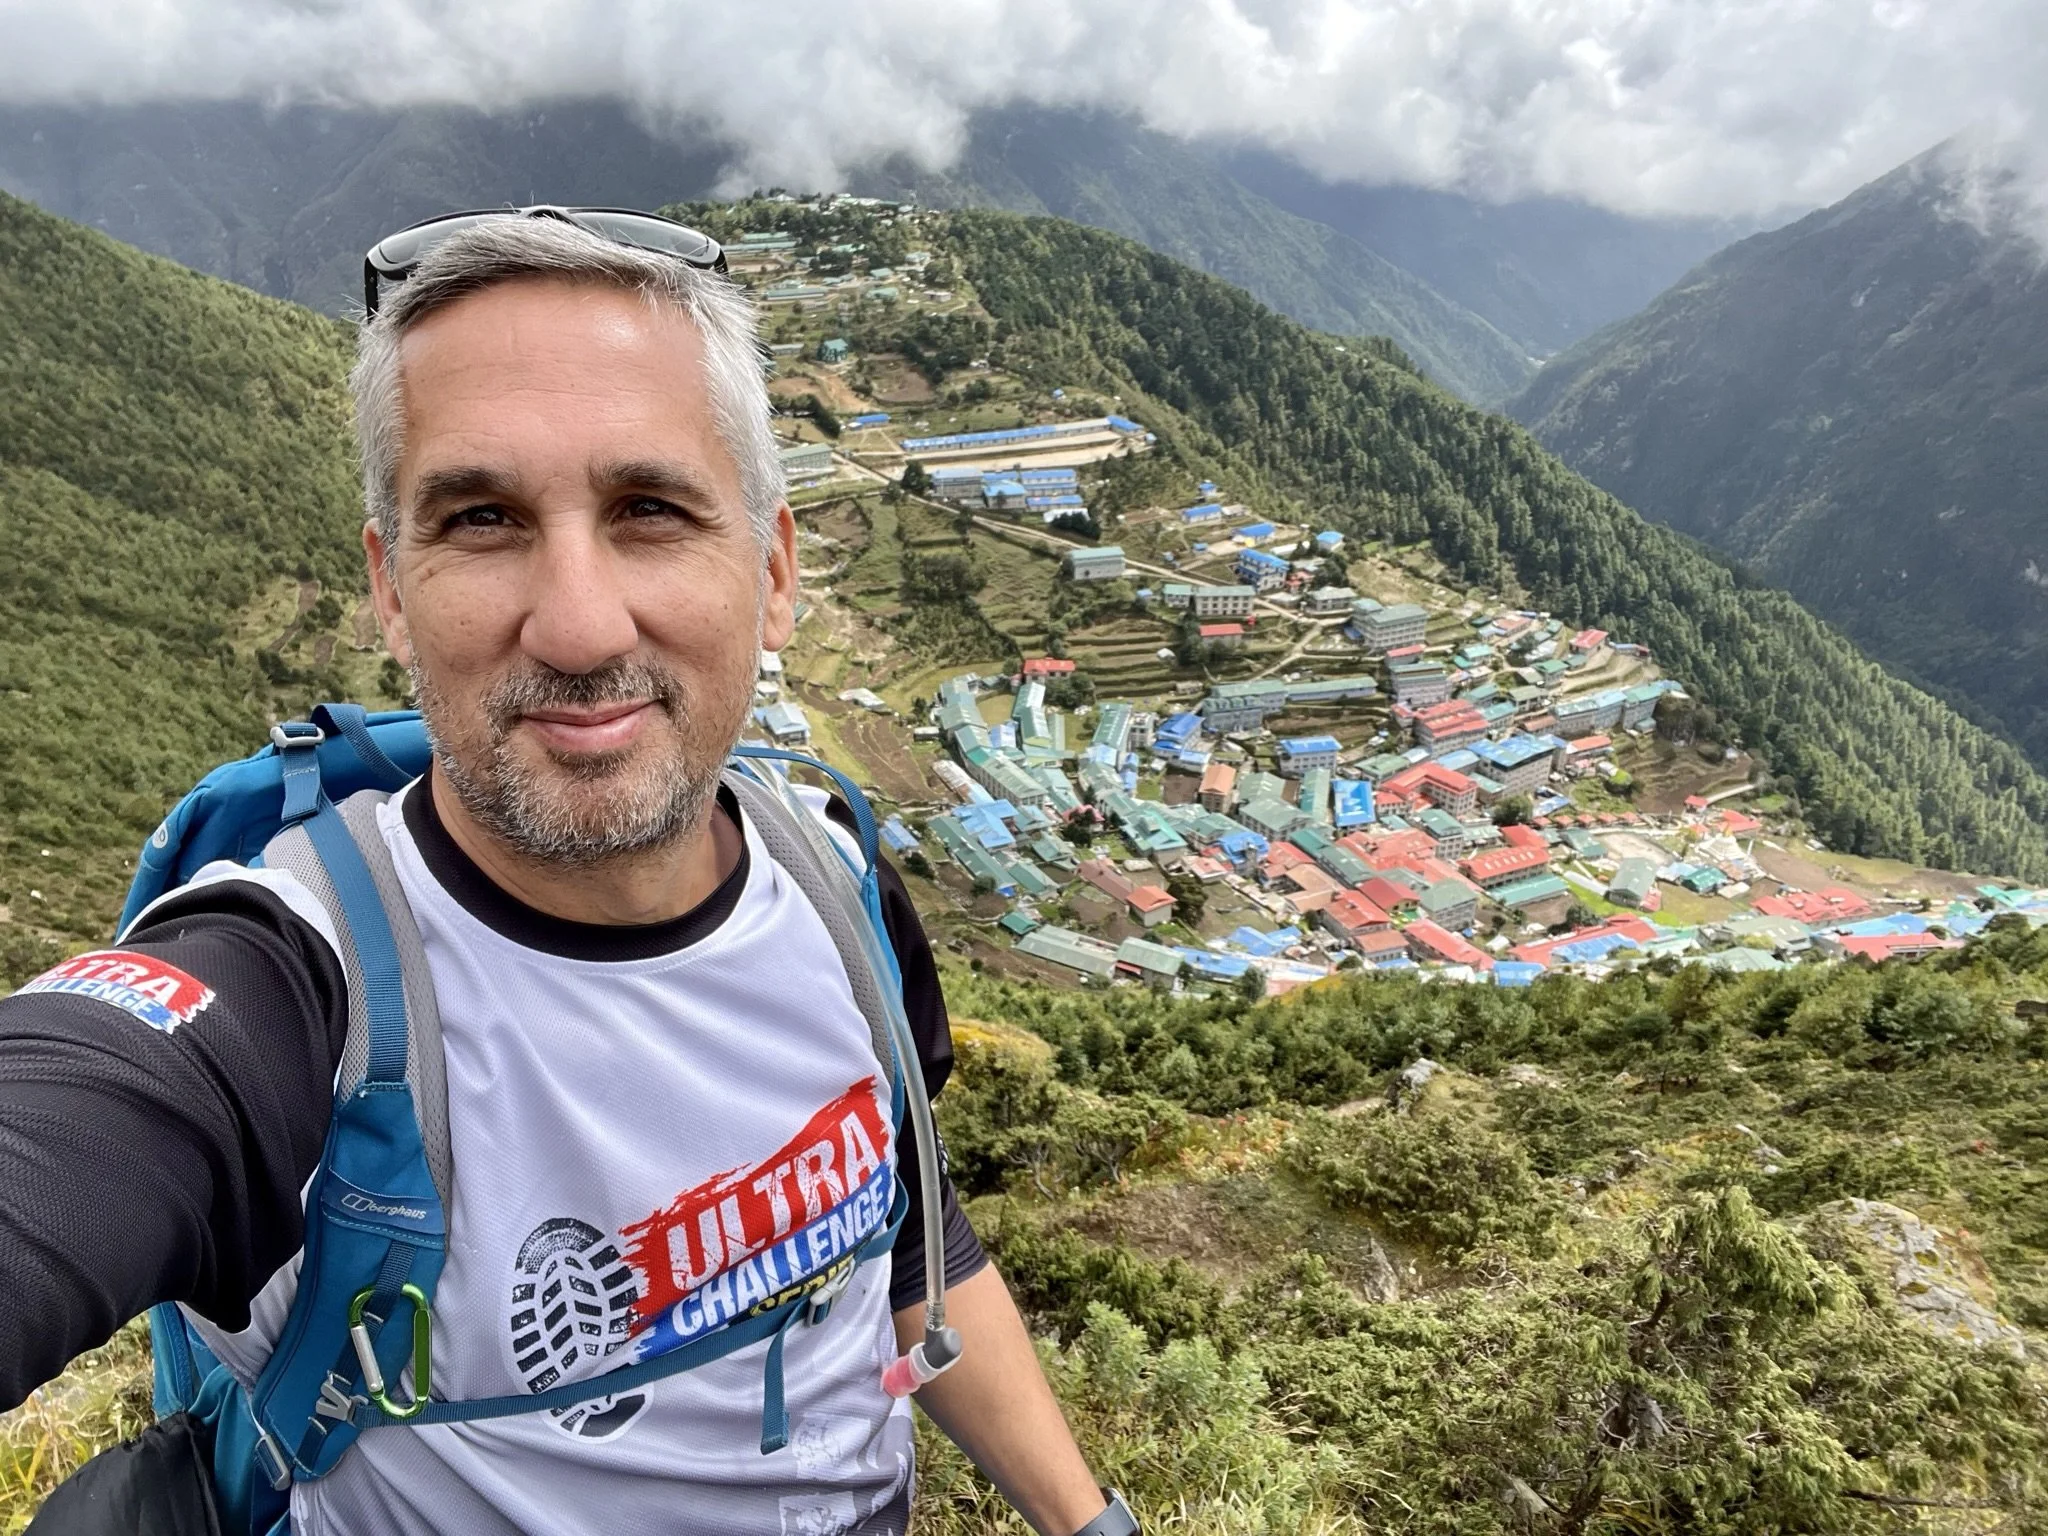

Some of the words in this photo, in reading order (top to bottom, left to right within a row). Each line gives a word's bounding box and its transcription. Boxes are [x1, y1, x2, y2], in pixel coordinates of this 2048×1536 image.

[42, 959, 181, 1004] LTRA
[368, 1202, 427, 1220] berghaus
[666, 1111, 881, 1291] ULTRA
[672, 1174, 886, 1337] CHALLENGE
